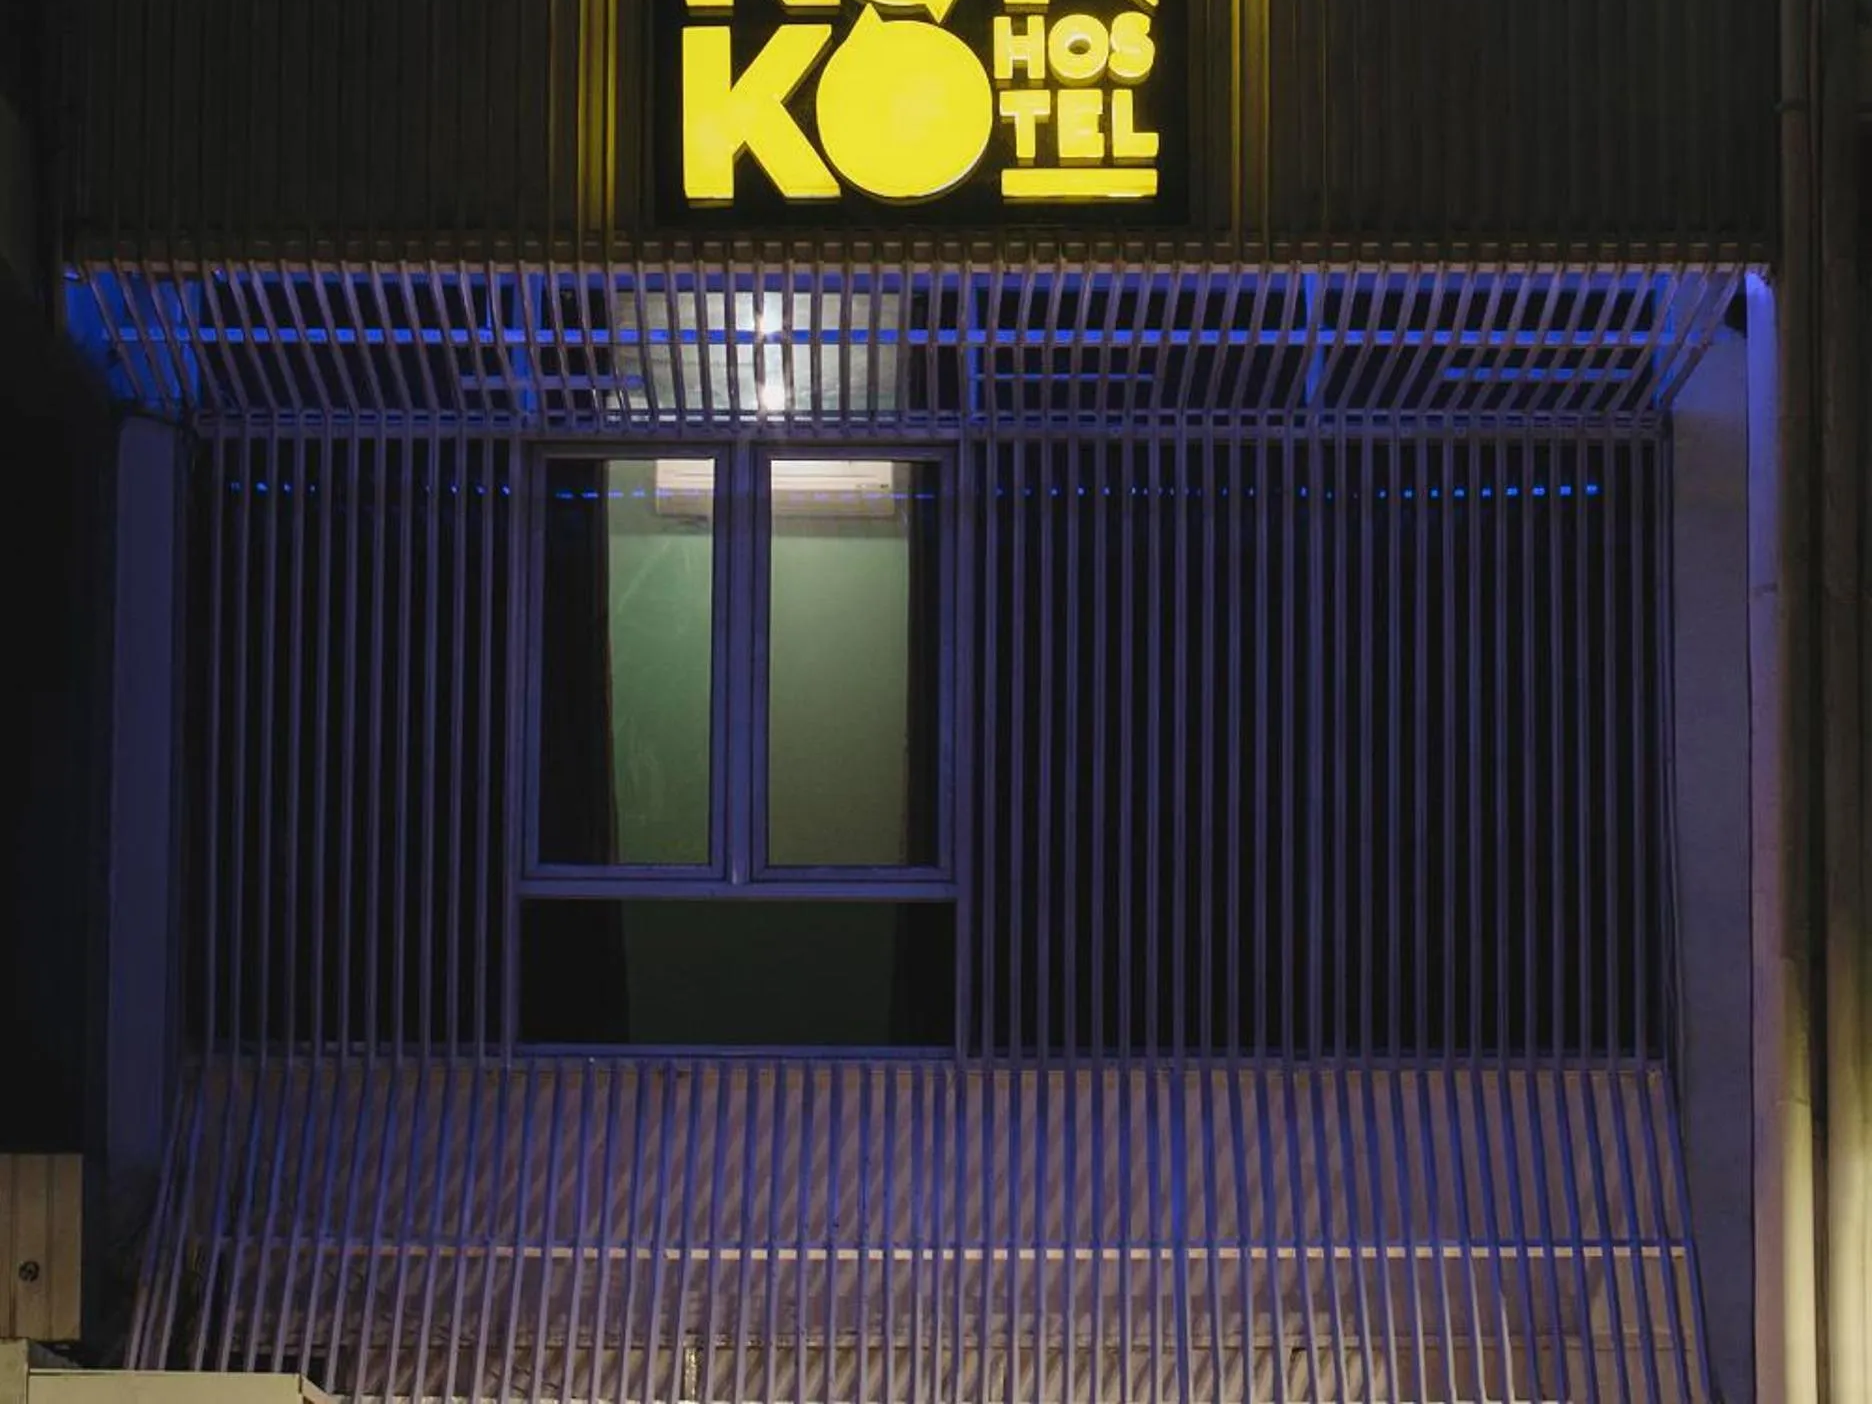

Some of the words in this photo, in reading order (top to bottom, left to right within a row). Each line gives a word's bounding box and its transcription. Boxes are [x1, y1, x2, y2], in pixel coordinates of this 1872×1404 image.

[993, 11, 1156, 85] HOS
[682, 5, 994, 202] KO
[999, 88, 1160, 163] TEL
